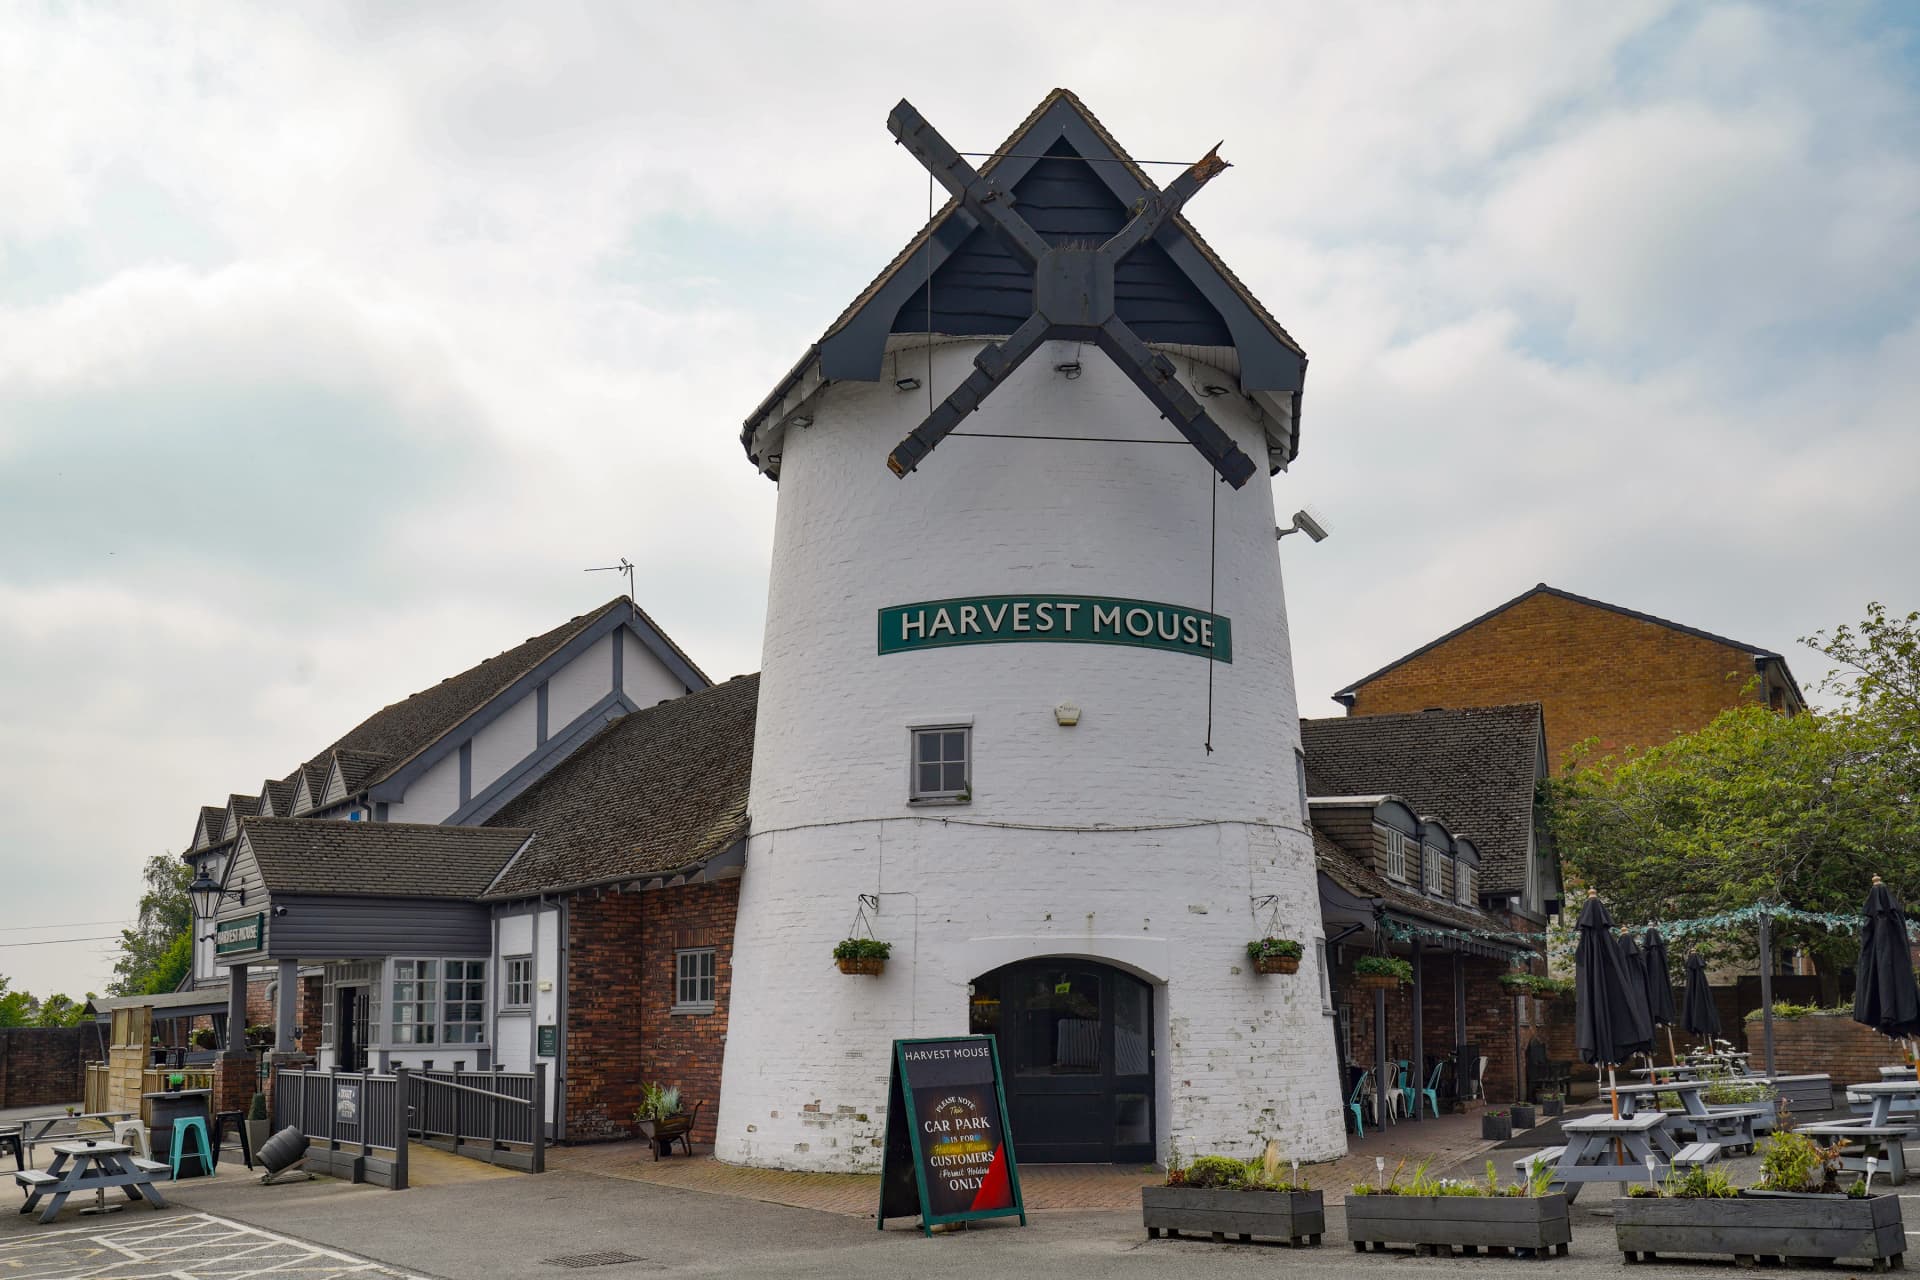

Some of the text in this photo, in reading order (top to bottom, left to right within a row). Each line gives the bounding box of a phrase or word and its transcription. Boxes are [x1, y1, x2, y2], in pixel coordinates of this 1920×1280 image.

[902, 602, 1216, 647] HARVEST MOUSE
[904, 1047, 990, 1061] HARVEST MOUSE
[936, 1096, 976, 1113] PLEASE NOTE
[924, 1116, 991, 1133] CAR PARK
[960, 1134, 975, 1142] FOR
[931, 1151, 995, 1167] CUSTOMERS
[949, 1177, 983, 1191] ONLY
